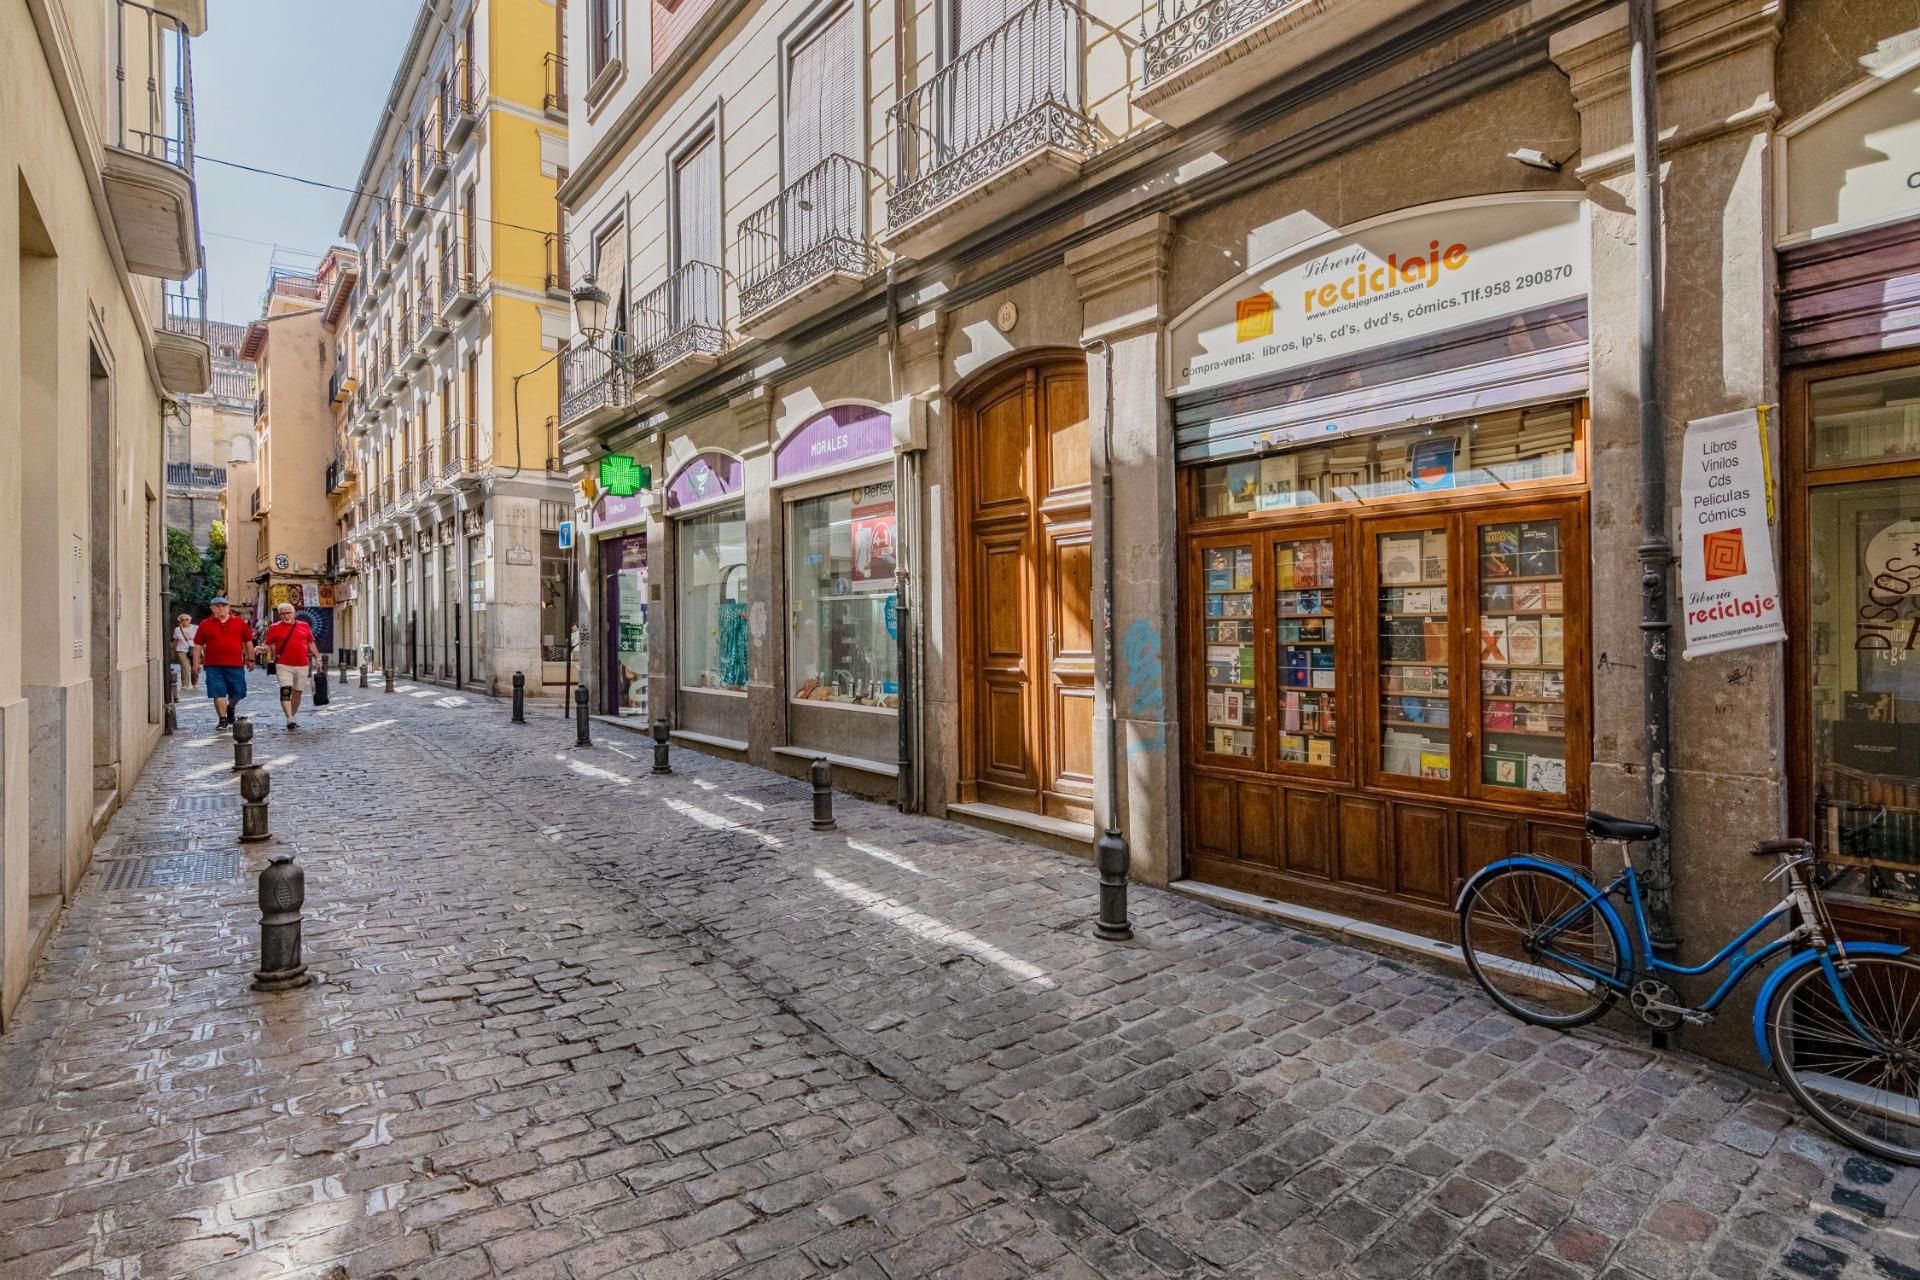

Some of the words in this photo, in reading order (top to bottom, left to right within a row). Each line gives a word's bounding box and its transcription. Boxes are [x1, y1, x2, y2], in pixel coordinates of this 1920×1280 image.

[1304, 240, 1470, 314] reciclaje
[1306, 282, 1424, 321] www.reciclajegranada.com
[1182, 351, 1256, 378] Compra-venta:
[1262, 341, 1299, 358] libros,
[1302, 332, 1327, 348] lp's,
[1330, 323, 1360, 340] cd's,
[1363, 311, 1404, 330] dvd's,
[1515, 263, 1574, 291] 290870
[811, 434, 848, 457] MORALES
[1703, 440, 1737, 455] Libros
[1702, 456, 1739, 473] Vinilos
[1708, 474, 1732, 488] Cds
[1698, 507, 1746, 525] Cómics
[1688, 594, 1776, 625] reciclaje
